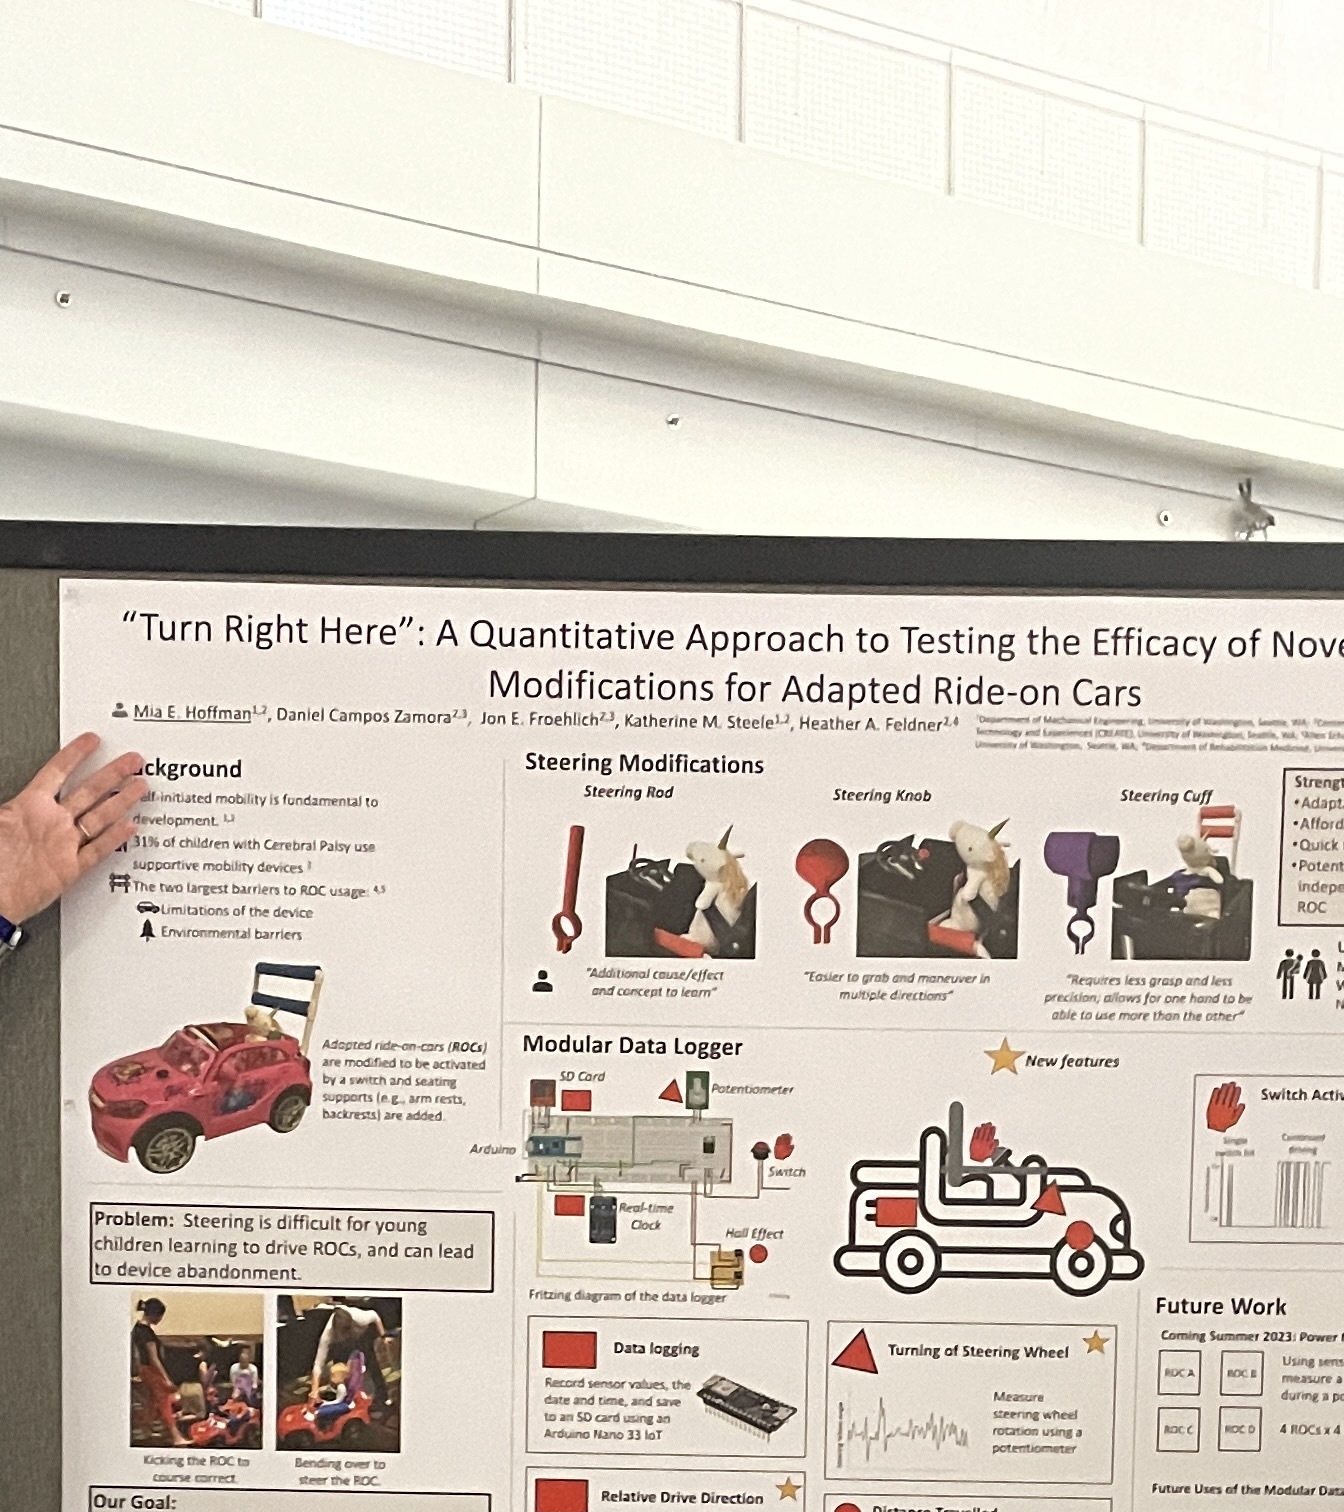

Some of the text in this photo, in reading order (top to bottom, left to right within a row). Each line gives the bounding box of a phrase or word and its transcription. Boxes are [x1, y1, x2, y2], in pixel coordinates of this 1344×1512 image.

[226, 614, 308, 650] Right
[436, 619, 458, 646] A
[470, 620, 674, 650] Quantitative
[685, 624, 843, 658] Approach
[856, 628, 888, 653] to
[900, 626, 1015, 662] Testing
[1027, 626, 1079, 656] the
[1094, 627, 1216, 663] Efficacy
[1228, 628, 1261, 658] of
[490, 670, 1140, 710] Modifications for Adapted Ride-on Cars
[133, 704, 163, 720] Mia
[277, 707, 325, 722] Daniel
[329, 708, 390, 724] Campos
[480, 712, 506, 725] Jon
[624, 714, 697, 728] Katherine
[799, 716, 860, 731] Heather
[134, 758, 242, 781] ckground
[526, 753, 763, 776] Steering Modifications
[584, 785, 674, 801] Steering Rod
[832, 788, 931, 804] Steering Knob
[1120, 789, 1213, 808] Steering Cuff
[1297, 901, 1326, 914] ROC
[523, 1035, 743, 1060] Modular Data Logger
[1024, 1054, 1119, 1069] New features
[711, 1083, 794, 1096] Potentiometer
[1261, 1088, 1307, 1101] Switch
[469, 1144, 516, 1155] Arduino
[768, 1166, 806, 1177] Switch
[94, 1211, 427, 1236] Problem: Steering is difficult for young
[631, 1219, 661, 1231] Clock
[725, 1227, 784, 1242] Hall Effect
[93, 1236, 473, 1259] children learning to drive ROCs, and can lead
[93, 1262, 301, 1280] to device abandonment.
[1156, 1297, 1286, 1315] Future Work
[614, 1342, 699, 1358] Data logging
[888, 1344, 1068, 1360] Turning of Steering Wheel
[93, 1494, 176, 1510] Our Goal:
[601, 1490, 763, 1505] Relative Drive Direction
